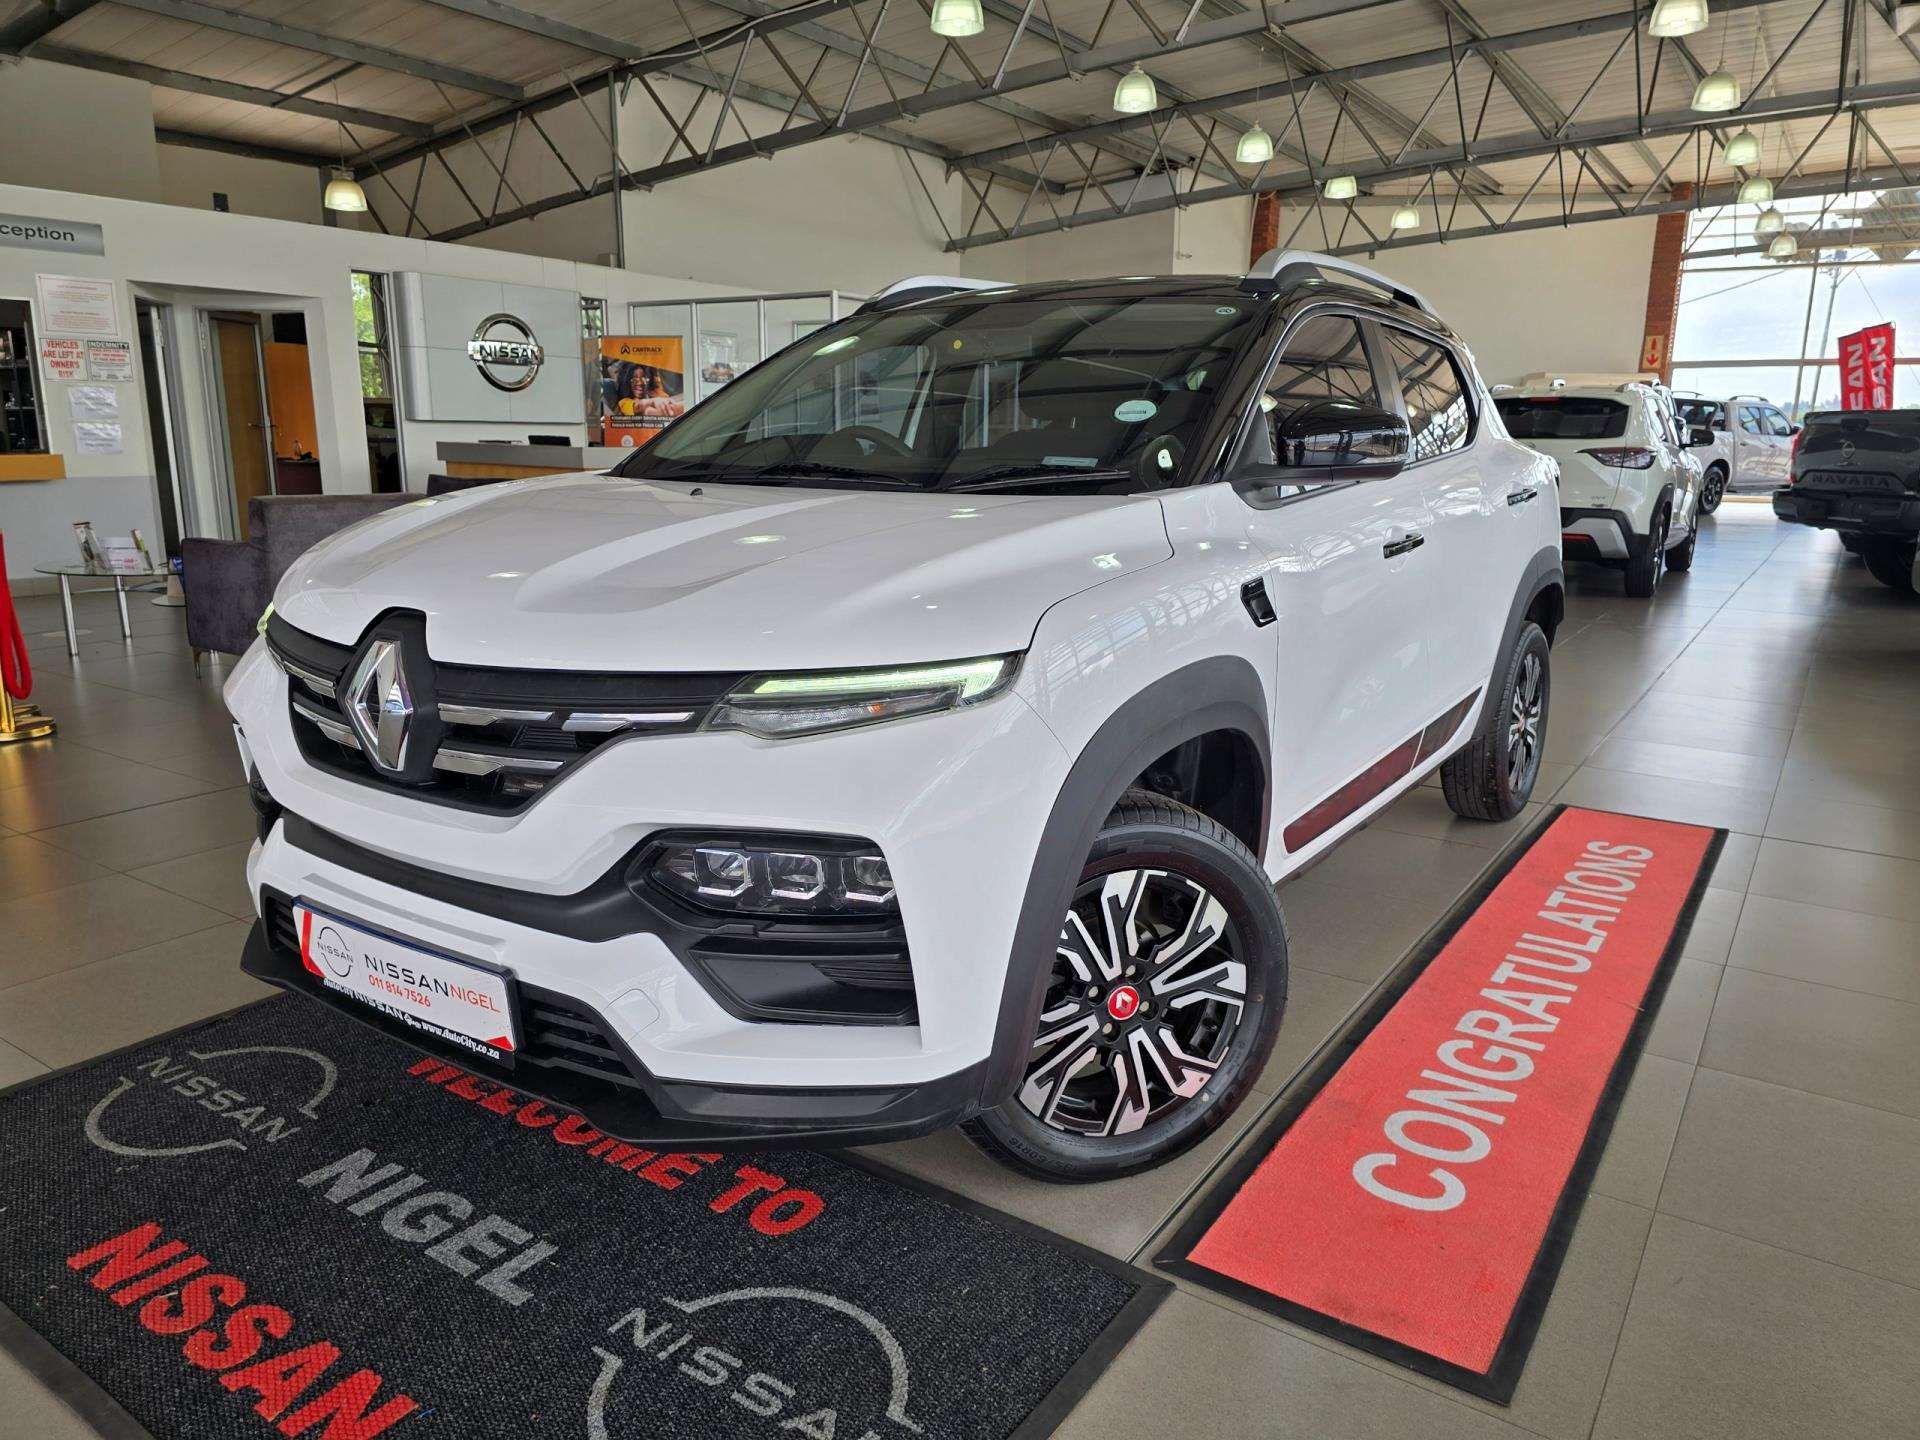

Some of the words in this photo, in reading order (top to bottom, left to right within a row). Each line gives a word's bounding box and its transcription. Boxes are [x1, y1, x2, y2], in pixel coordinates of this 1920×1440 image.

[43, 350, 56, 358] ARE
[58, 351, 74, 359] LEFT
[76, 351, 84, 359] AT
[47, 340, 79, 350] VEHICLES
[87, 341, 129, 350] INDEMNITY
[479, 344, 538, 361] NISSAN
[1811, 473, 1890, 489] NAVARA
[317, 941, 354, 964] NISSAN
[355, 991, 404, 1021] NISSAN
[368, 974, 384, 991] 011
[386, 980, 403, 998] 814
[404, 987, 431, 1008] 7526
[1352, 841, 1655, 1212] CONGRATULATIONS
[137, 1056, 300, 1143] NISSAN
[708, 1164, 827, 1237] TO
[298, 1148, 559, 1306] NIGEL
[67, 1220, 420, 1440] NISSAN
[606, 1307, 880, 1440] NISSA
